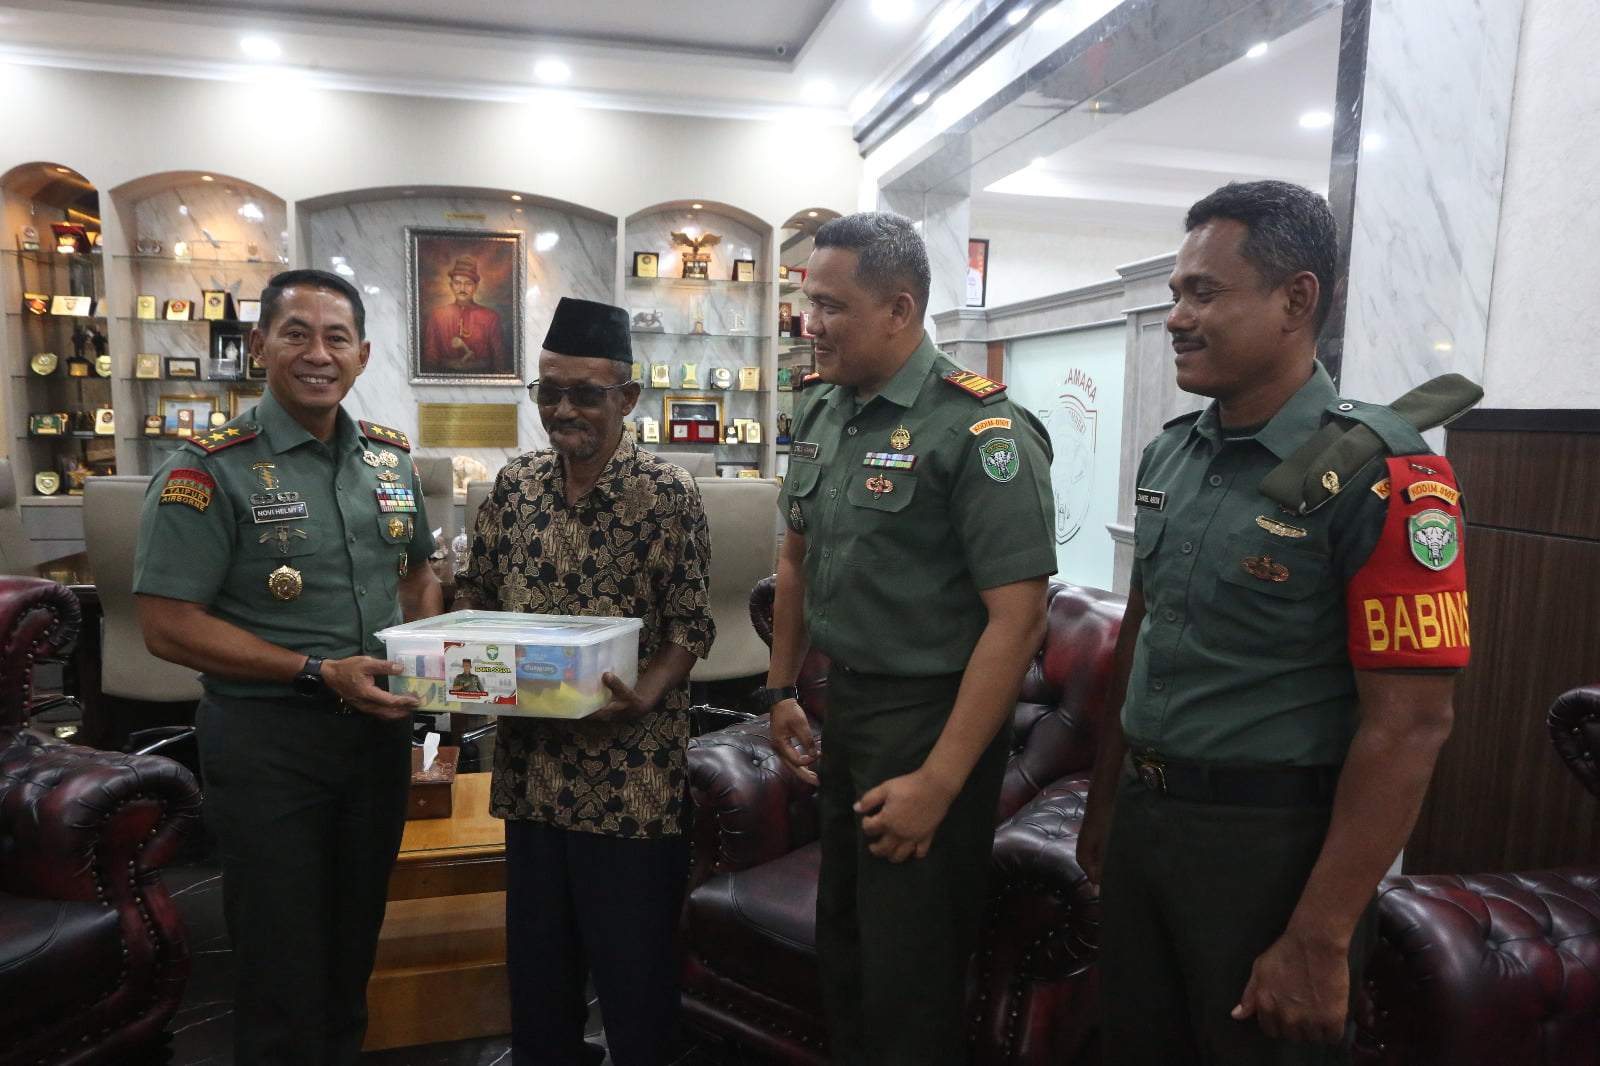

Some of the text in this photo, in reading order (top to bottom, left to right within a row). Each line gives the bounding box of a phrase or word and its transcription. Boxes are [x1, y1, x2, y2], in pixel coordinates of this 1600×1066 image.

[1064, 368, 1097, 403] AMARA
[169, 487, 205, 502] TAIPUR
[1411, 483, 1438, 497] KODIM
[161, 495, 205, 512] AIRBORNE
[257, 509, 275, 517] NOVI
[275, 506, 297, 515] HELMY
